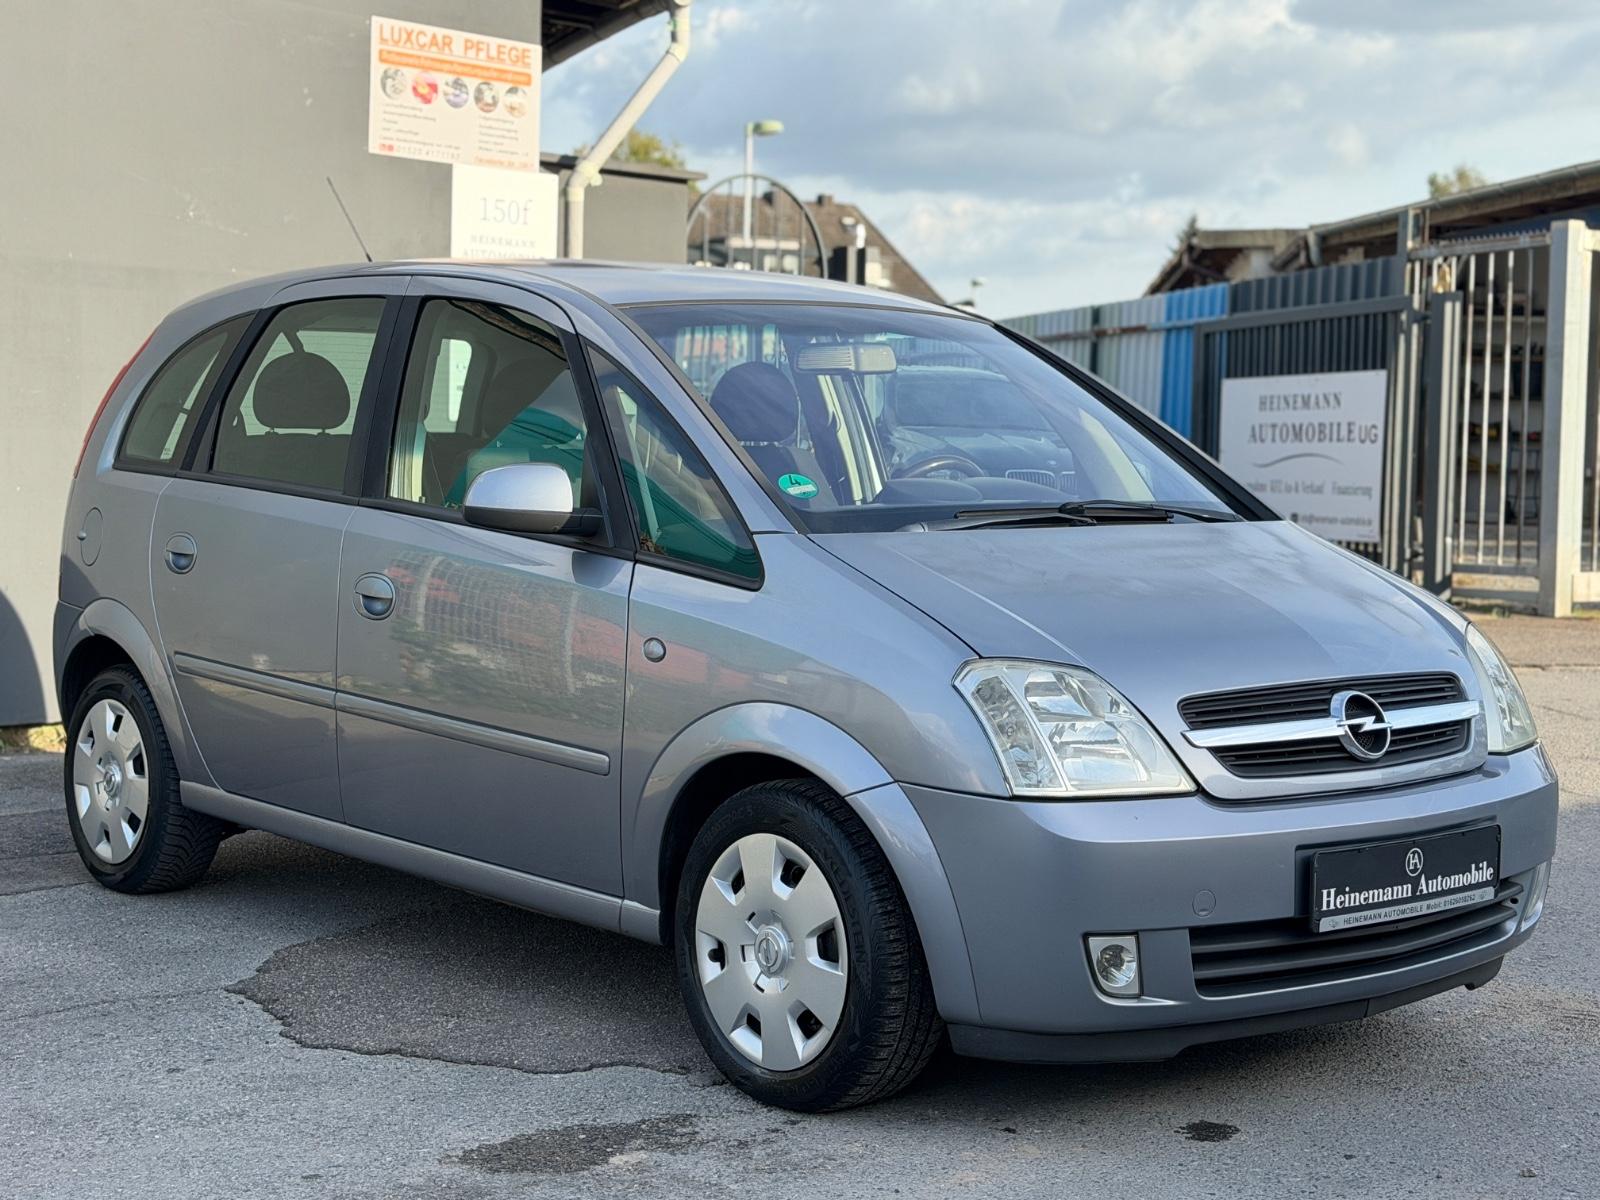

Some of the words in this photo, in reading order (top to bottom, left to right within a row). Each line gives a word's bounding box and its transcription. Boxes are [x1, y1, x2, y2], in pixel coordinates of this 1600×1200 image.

[379, 23, 453, 51] LUXCAR
[464, 38, 532, 66] PFLEGE
[480, 197, 533, 226] 150f
[470, 234, 537, 248] HEINEMANN
[1259, 391, 1342, 412] HEINEMANN
[1248, 421, 1356, 444] AUTOMOBILE
[1358, 424, 1379, 444] UG
[788, 475, 802, 487] 4
[1321, 883, 1413, 911] Heinemann
[1416, 861, 1494, 896] Automobile
[1343, 912, 1382, 926] HEINEMANN
[1384, 904, 1424, 919] AUTOMOBILE
